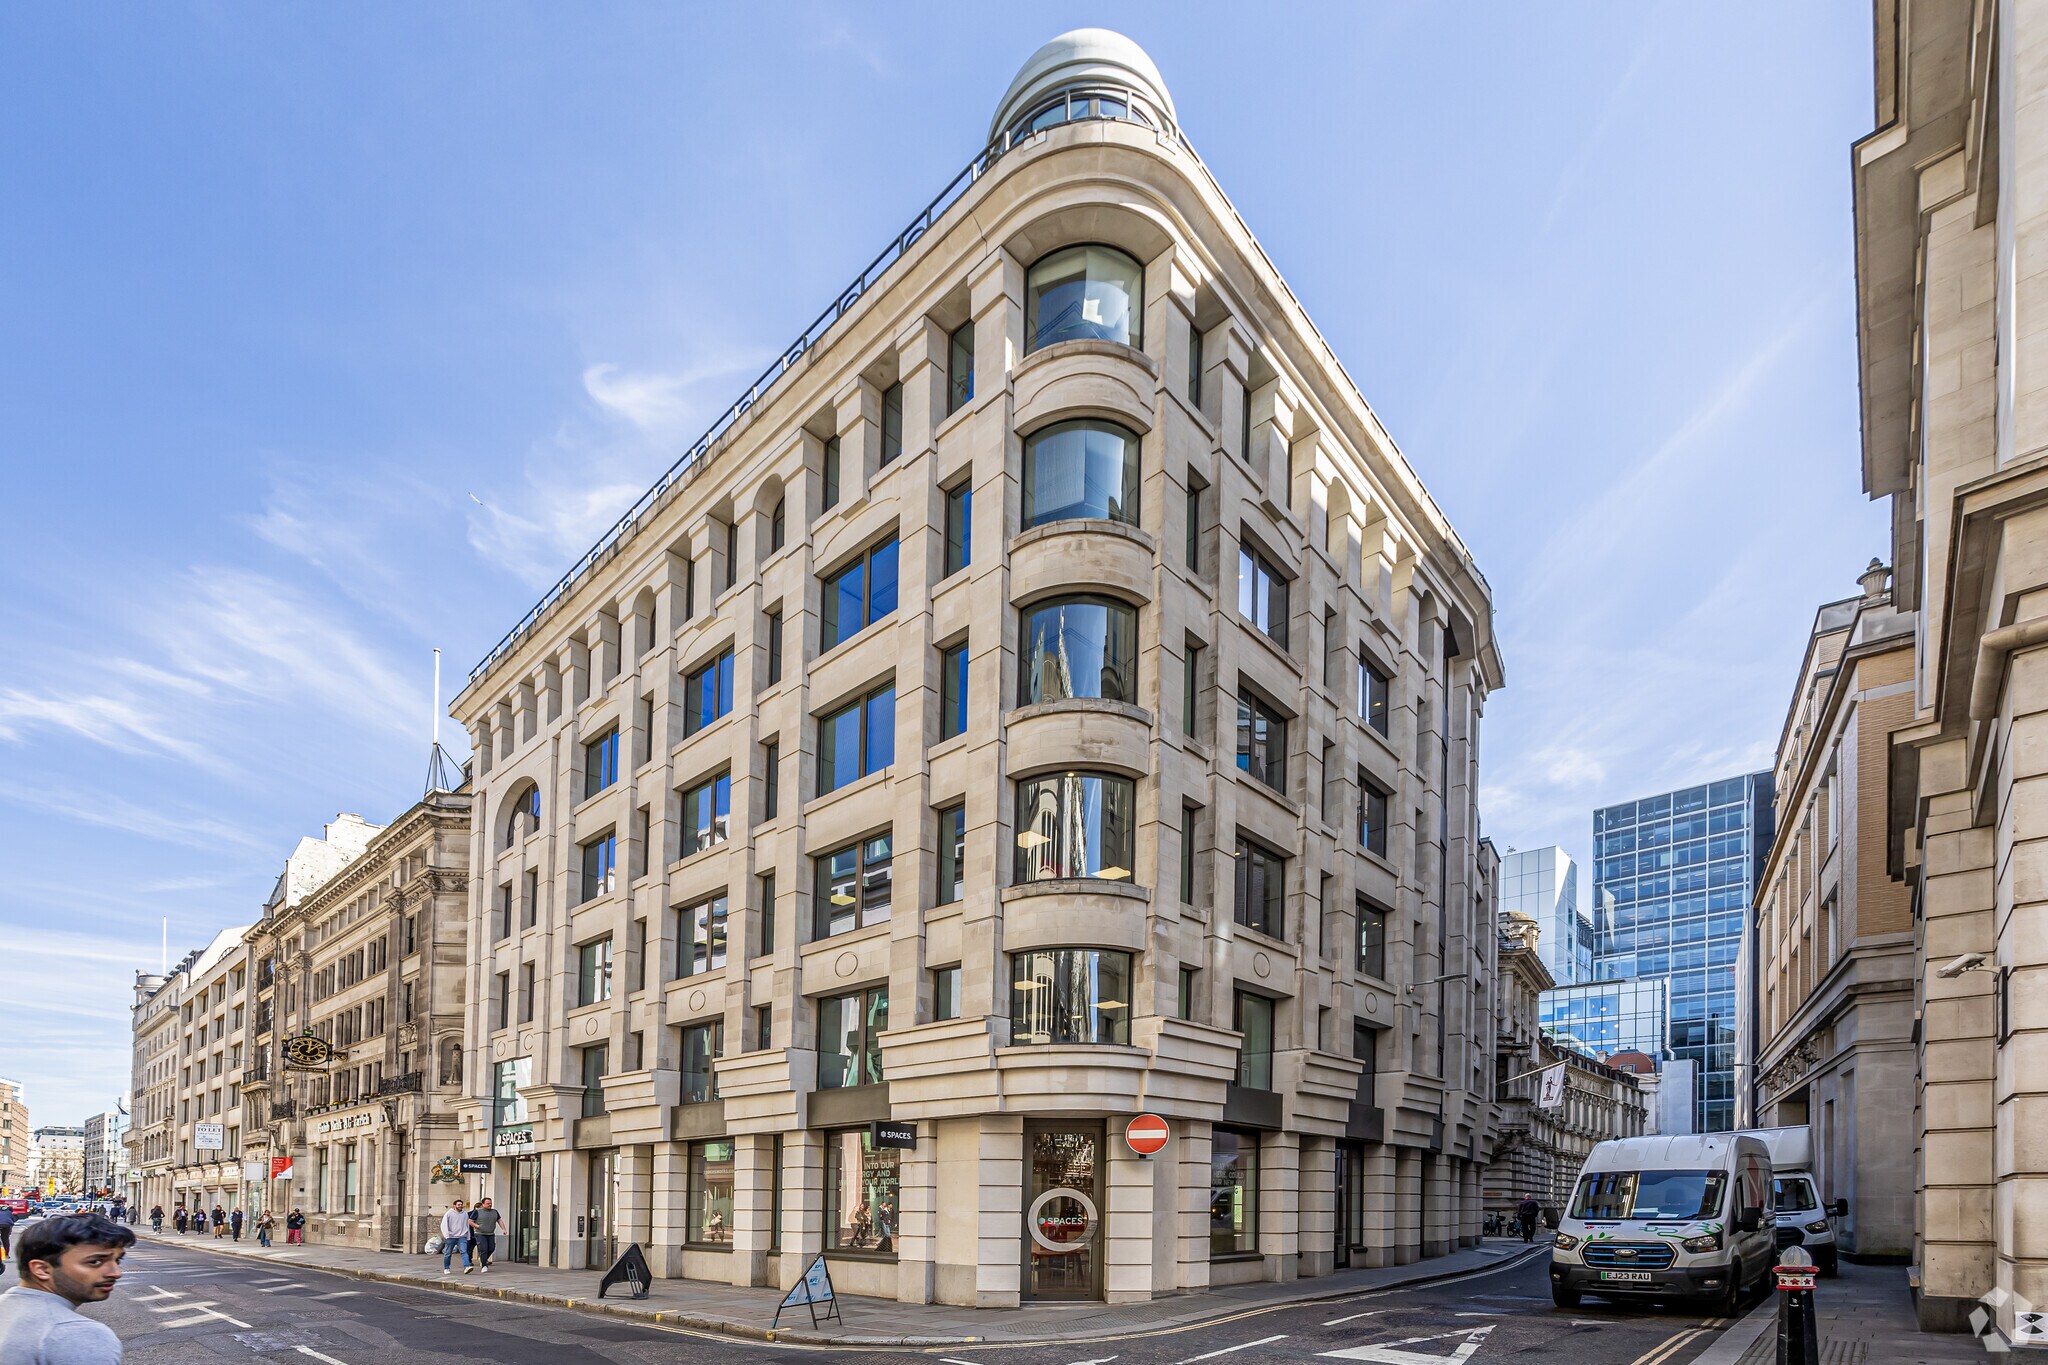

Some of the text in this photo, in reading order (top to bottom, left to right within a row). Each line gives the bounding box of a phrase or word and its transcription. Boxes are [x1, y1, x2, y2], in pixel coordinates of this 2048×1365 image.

[887, 1131, 913, 1140] SPACES.
[881, 1161, 895, 1169] OUR
[876, 1170, 890, 1178] AND
[1047, 1217, 1086, 1225] SPACES.
[1606, 1272, 1650, 1281] EJ23 RAU
